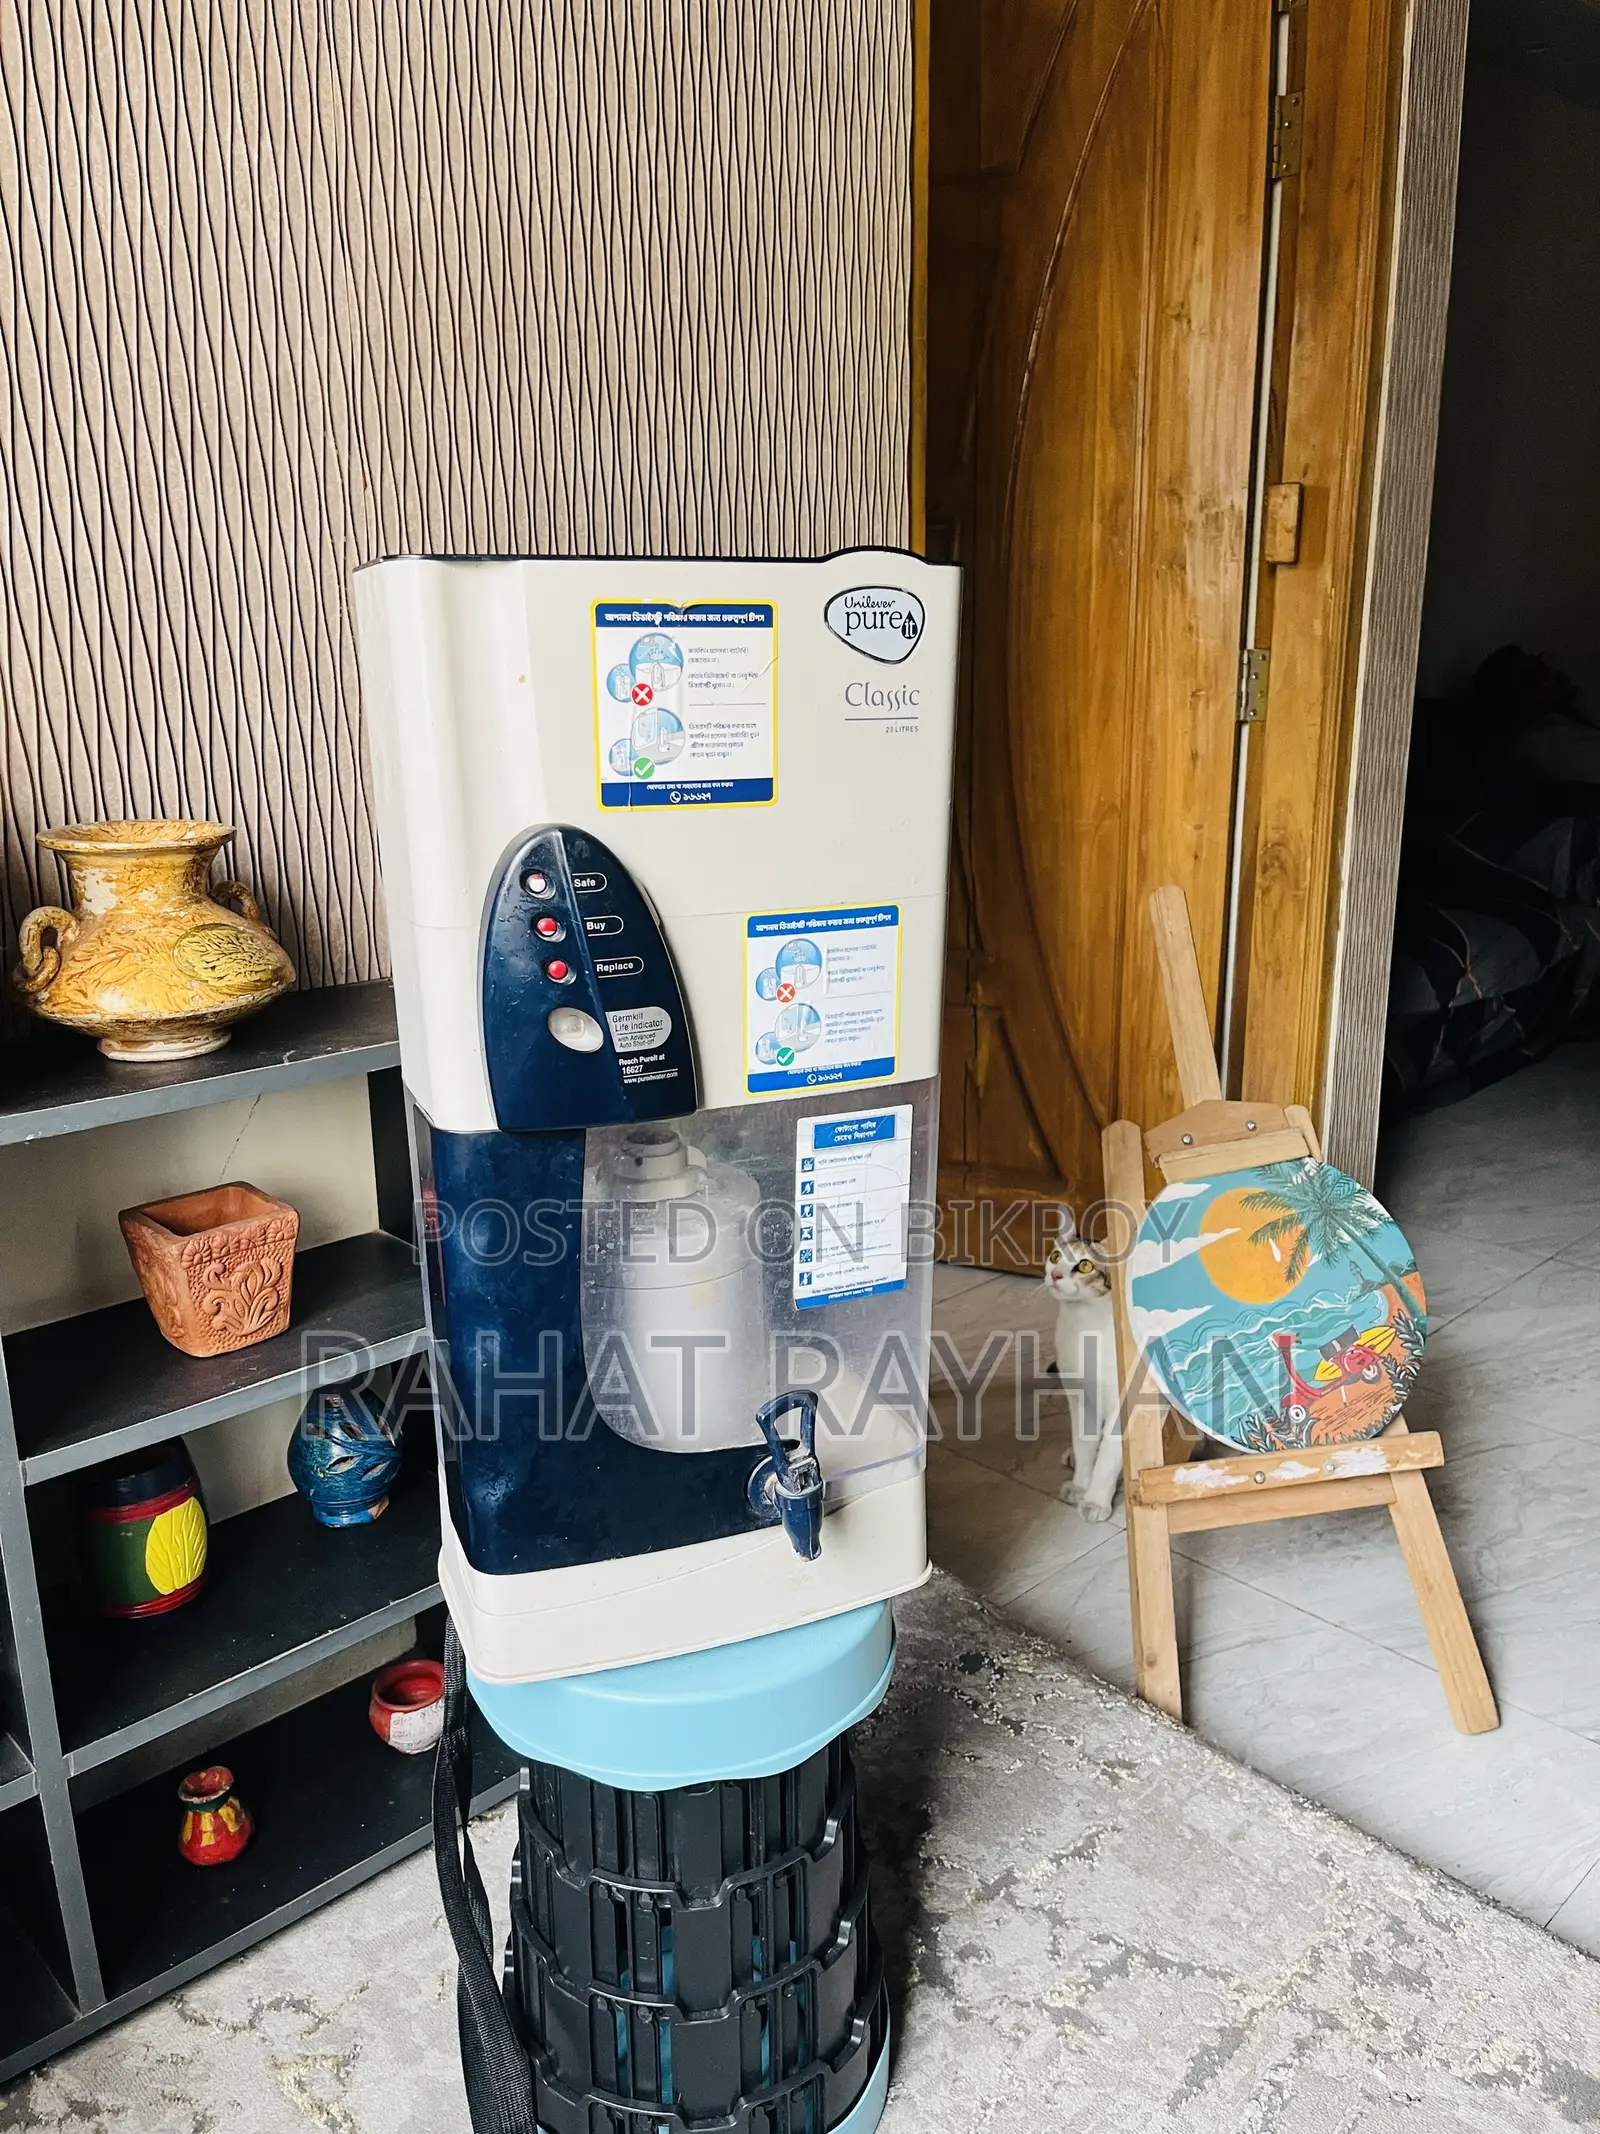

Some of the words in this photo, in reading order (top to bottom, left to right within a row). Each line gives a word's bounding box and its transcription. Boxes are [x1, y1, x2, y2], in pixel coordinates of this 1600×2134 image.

[844, 596, 895, 609] Unilever
[845, 682, 920, 711] Classic
[683, 792, 711, 801] ১৬৬২৭
[574, 878, 596, 887] Safe
[586, 922, 606, 931] Buy
[596, 962, 634, 973] Replace
[612, 1013, 643, 1023] Germkill
[615, 1024, 629, 1032] Life
[631, 1020, 663, 1029] Indicator
[630, 1033, 656, 1041] Advanced
[633, 1039, 655, 1047] Shut-off
[619, 1058, 638, 1066] Reach
[640, 1054, 658, 1063] Pureit
[622, 1065, 643, 1074] 16627
[818, 1072, 842, 1081] ১৬৬২৭
